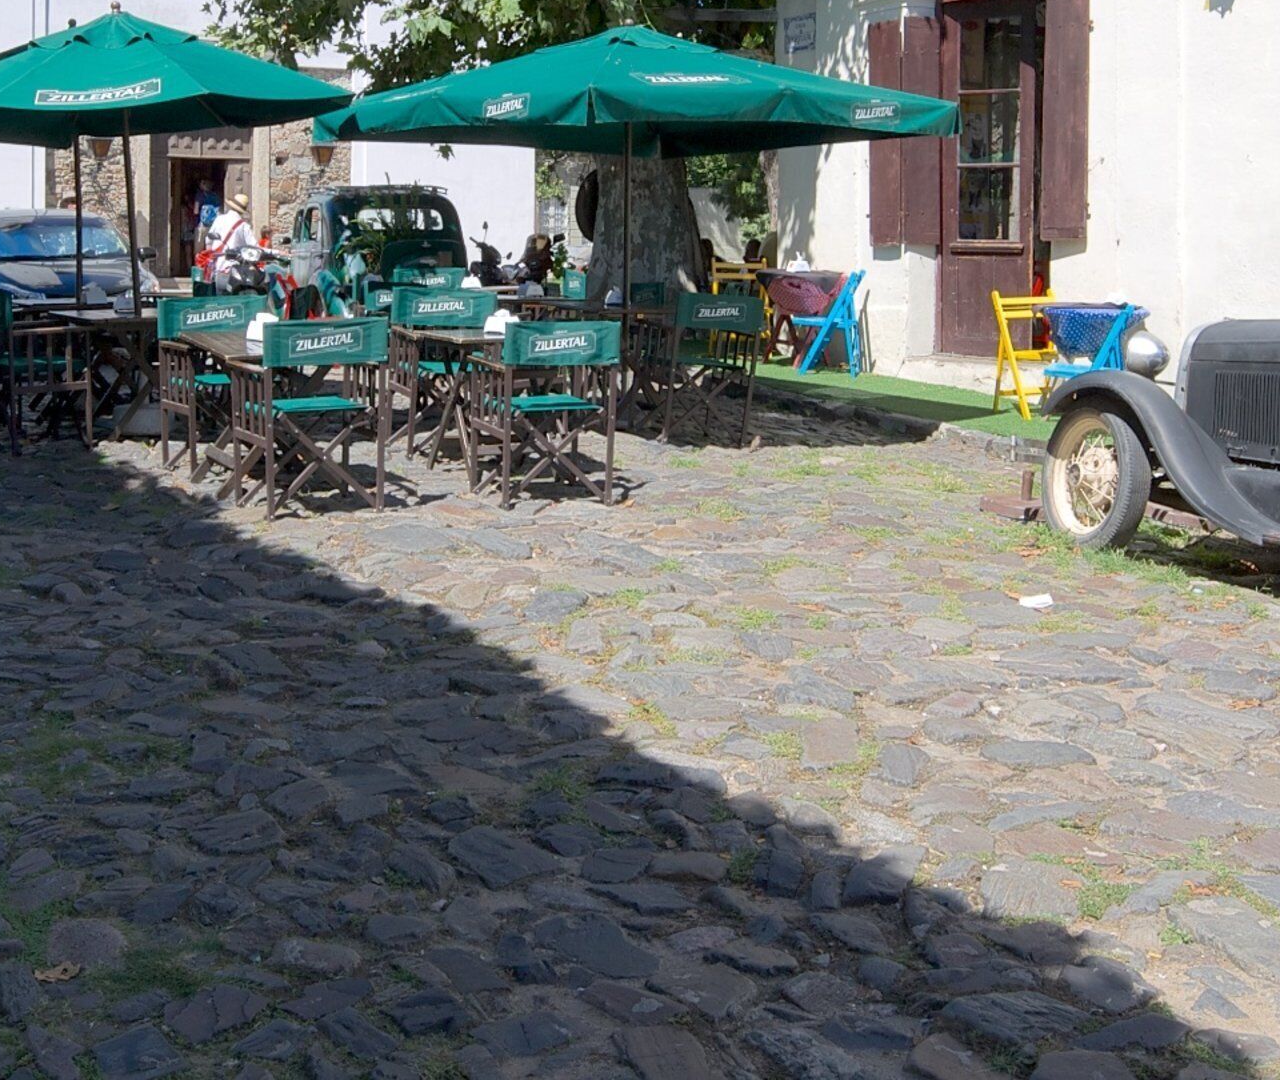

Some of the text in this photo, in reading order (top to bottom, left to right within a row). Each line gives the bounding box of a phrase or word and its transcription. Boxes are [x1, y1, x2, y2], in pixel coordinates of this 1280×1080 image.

[46, 85, 146, 102] ZILLERTAL
[486, 98, 524, 117] ZILLERTAL
[855, 106, 895, 119] ZILLERTAL
[418, 301, 465, 313] ZILLERTAL
[698, 307, 740, 318] ZILLERTAL
[186, 308, 236, 324] ZILLERTAL
[296, 332, 354, 351] ZILLERTAL
[534, 336, 588, 352] ZILLERTAL
